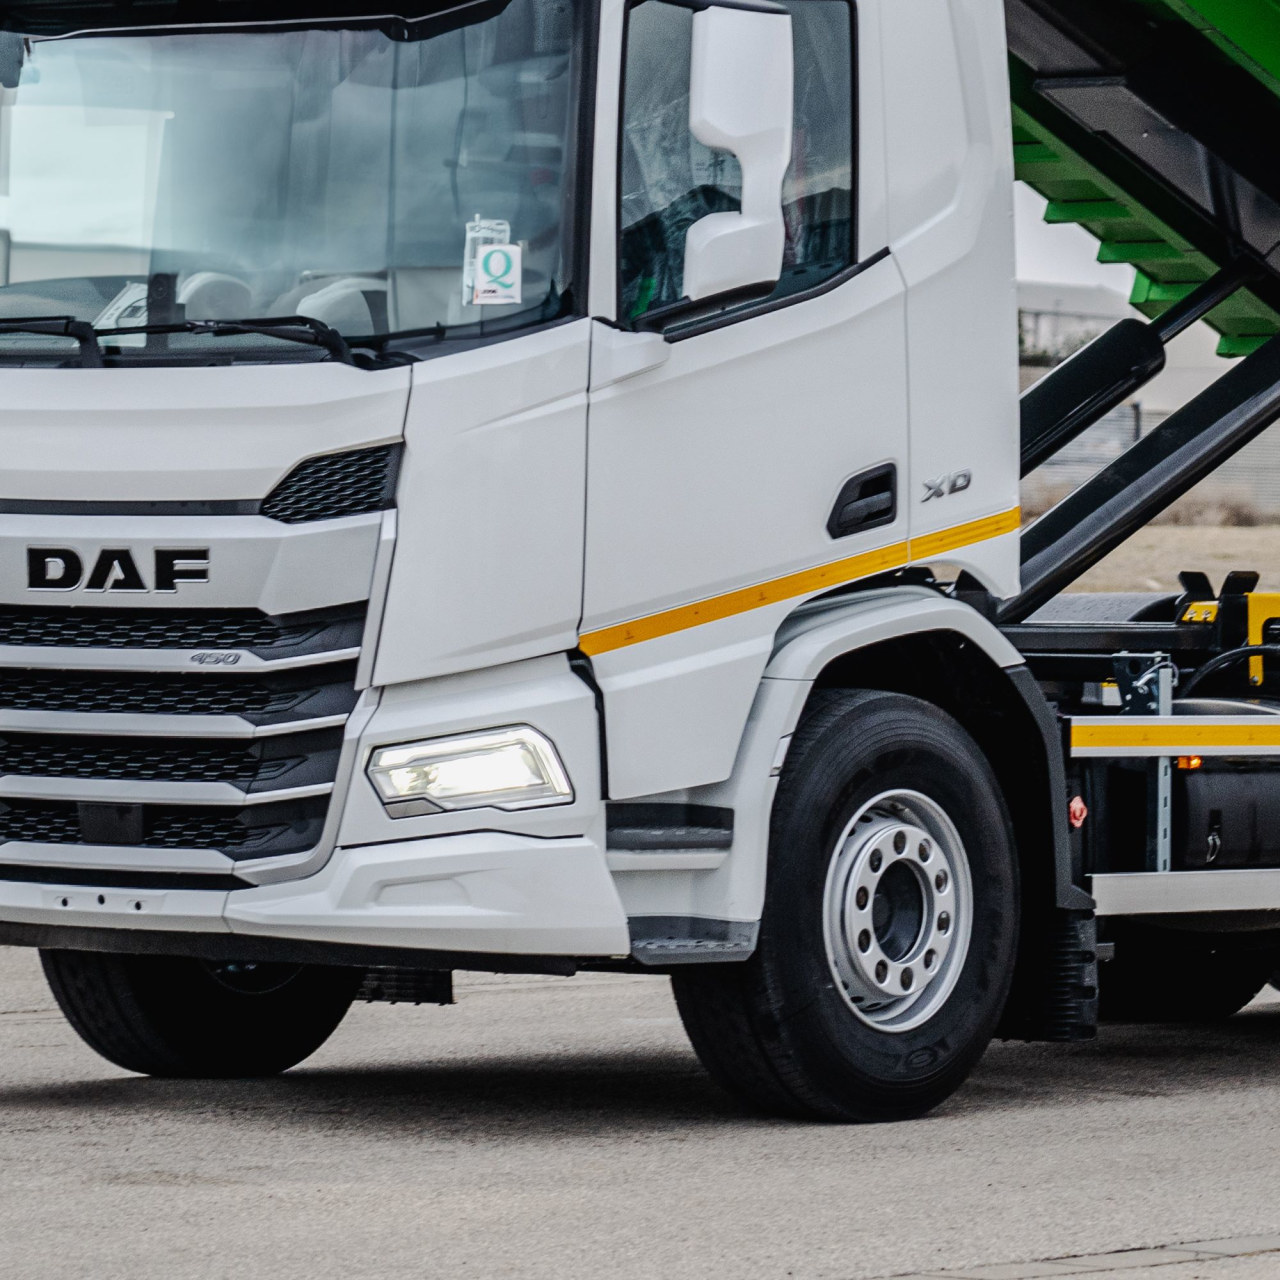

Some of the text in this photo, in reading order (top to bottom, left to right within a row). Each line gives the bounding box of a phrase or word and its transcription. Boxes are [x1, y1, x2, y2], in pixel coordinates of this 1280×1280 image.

[482, 249, 514, 289] Q
[921, 470, 971, 503] XD
[27, 545, 210, 593] DAF
[190, 652, 241, 665] 450
